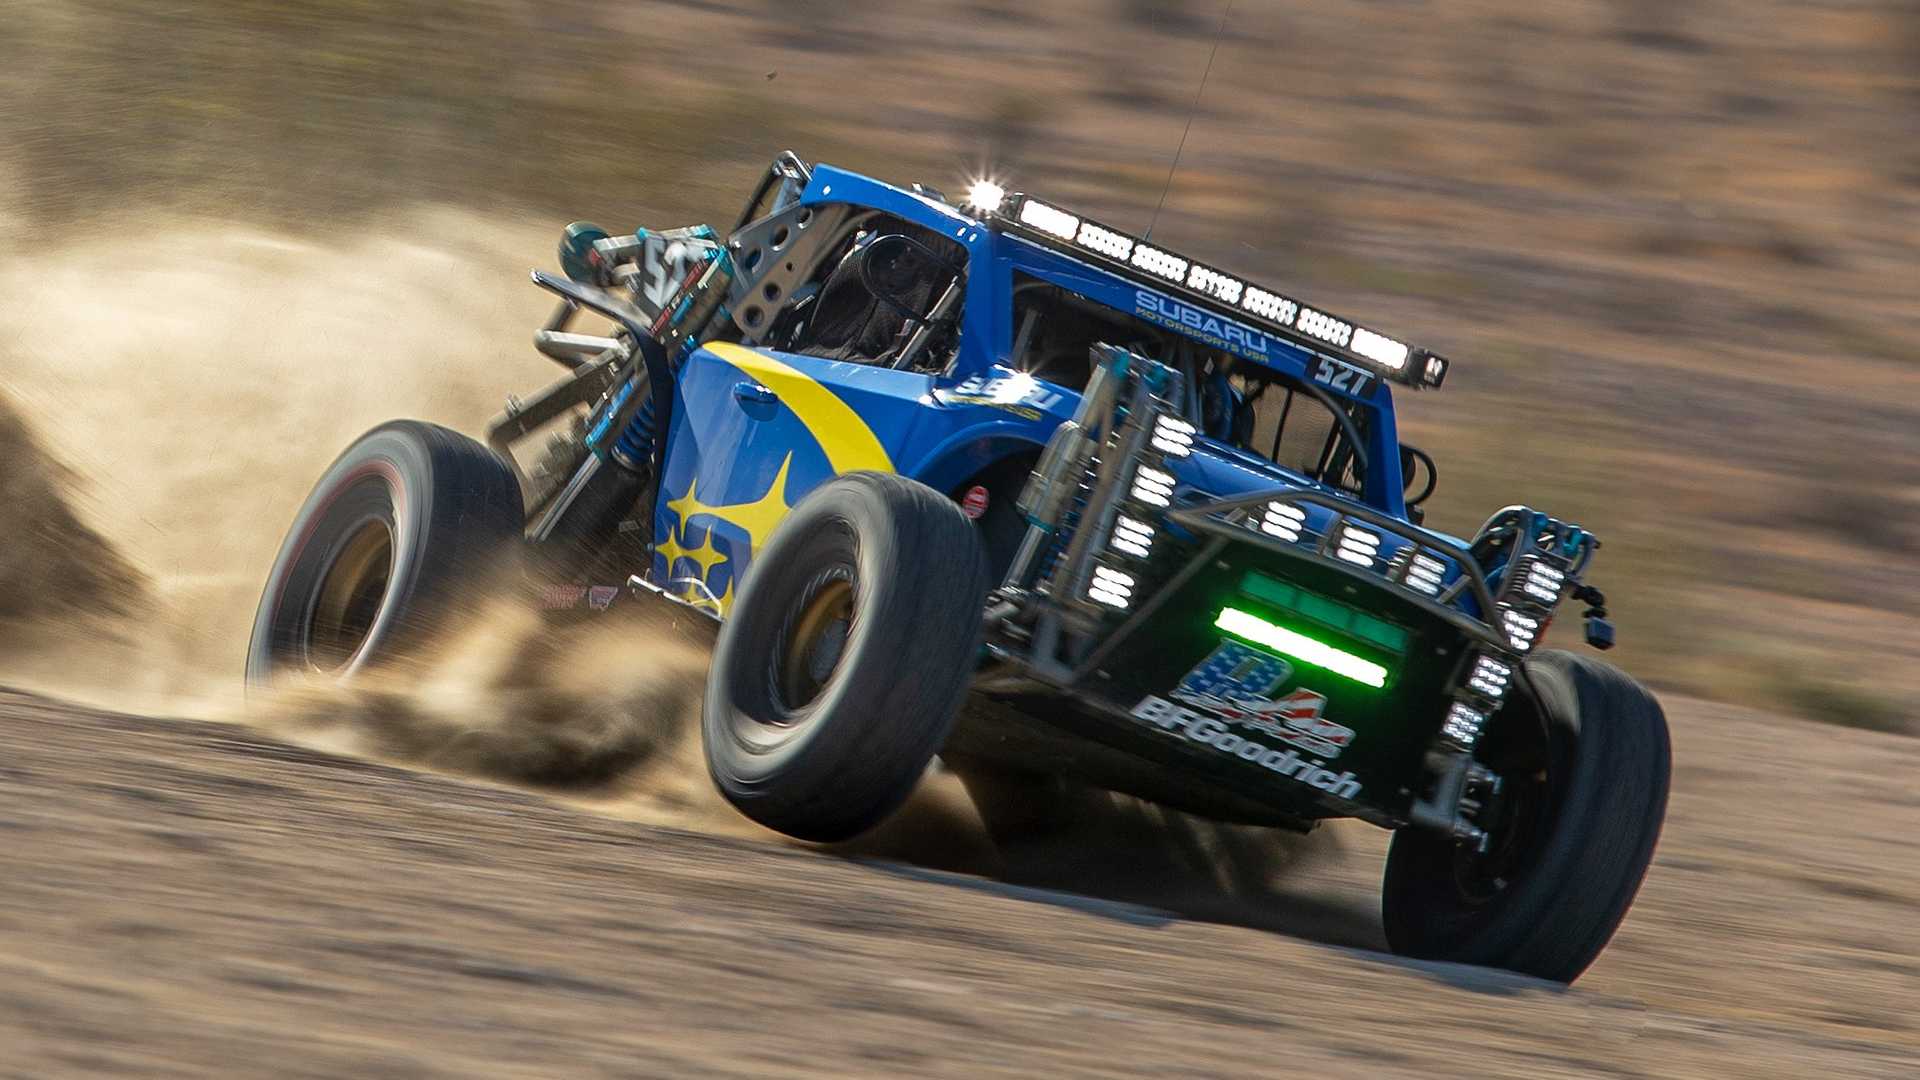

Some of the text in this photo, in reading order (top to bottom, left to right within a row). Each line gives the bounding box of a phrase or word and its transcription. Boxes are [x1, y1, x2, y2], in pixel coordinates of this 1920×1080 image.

[1135, 290, 1268, 353] SUBARU
[1135, 307, 1270, 365] MOTORSPORTS USA
[1131, 695, 1363, 799] BFGoodrich
